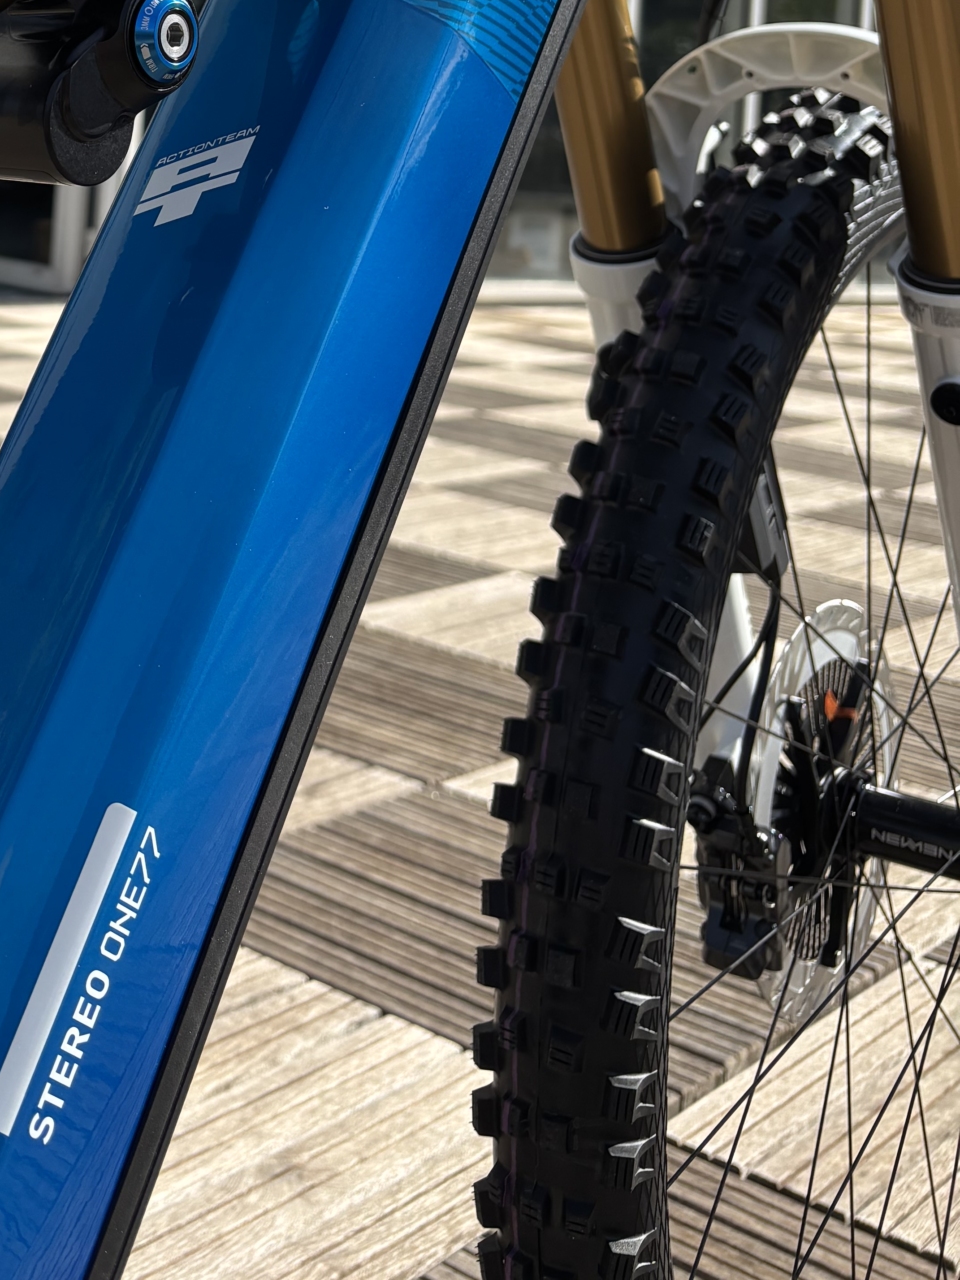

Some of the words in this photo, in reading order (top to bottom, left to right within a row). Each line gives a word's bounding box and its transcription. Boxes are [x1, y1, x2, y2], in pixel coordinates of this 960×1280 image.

[156, 125, 260, 167] ACTIONTEAM
[29, 969, 110, 1146] STEREO
[100, 825, 161, 962] ONE77
